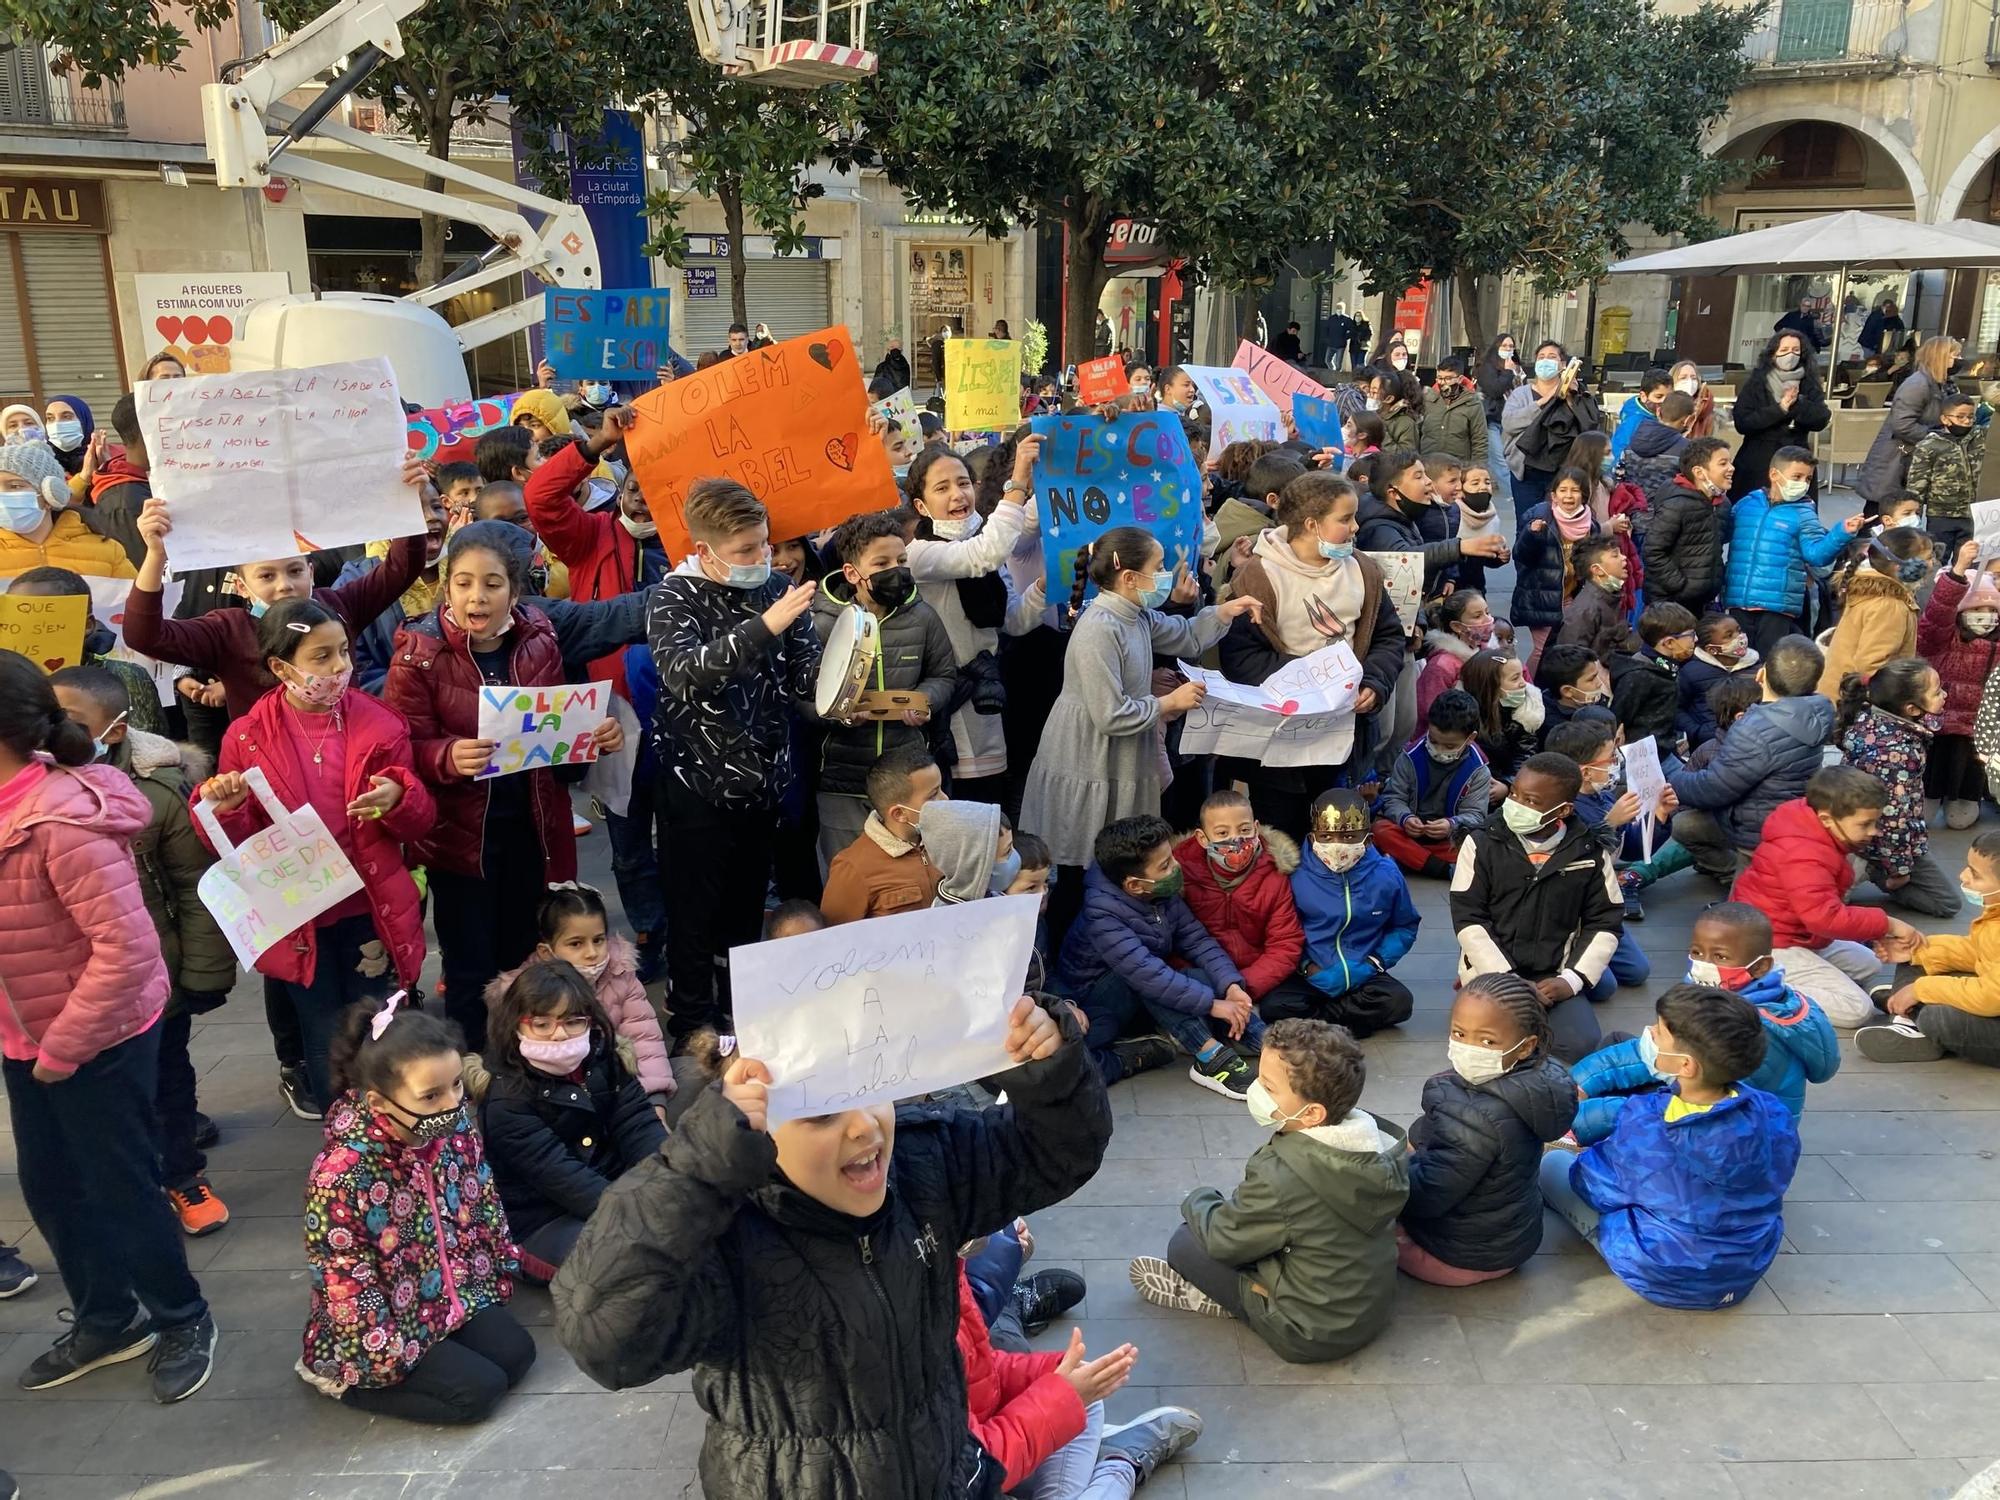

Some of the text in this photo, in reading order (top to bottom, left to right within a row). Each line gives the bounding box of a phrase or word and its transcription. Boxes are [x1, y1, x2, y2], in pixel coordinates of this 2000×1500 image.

[588, 180, 629, 192] La ciutat
[577, 193, 641, 206] de l'Empordà
[695, 268, 715, 280] lloga
[182, 284, 243, 295] A FIGUERES
[156, 299, 198, 309] ESTIMA
[199, 299, 225, 308] COM
[554, 295, 592, 323] ES
[634, 349, 790, 425] VOLEM
[704, 413, 753, 459] LA
[1048, 482, 1180, 526] NO ES
[17, 602, 57, 614] QUE
[1269, 653, 1356, 700] ISABEL
[482, 688, 598, 714] VOLEM
[521, 712, 562, 734] LA
